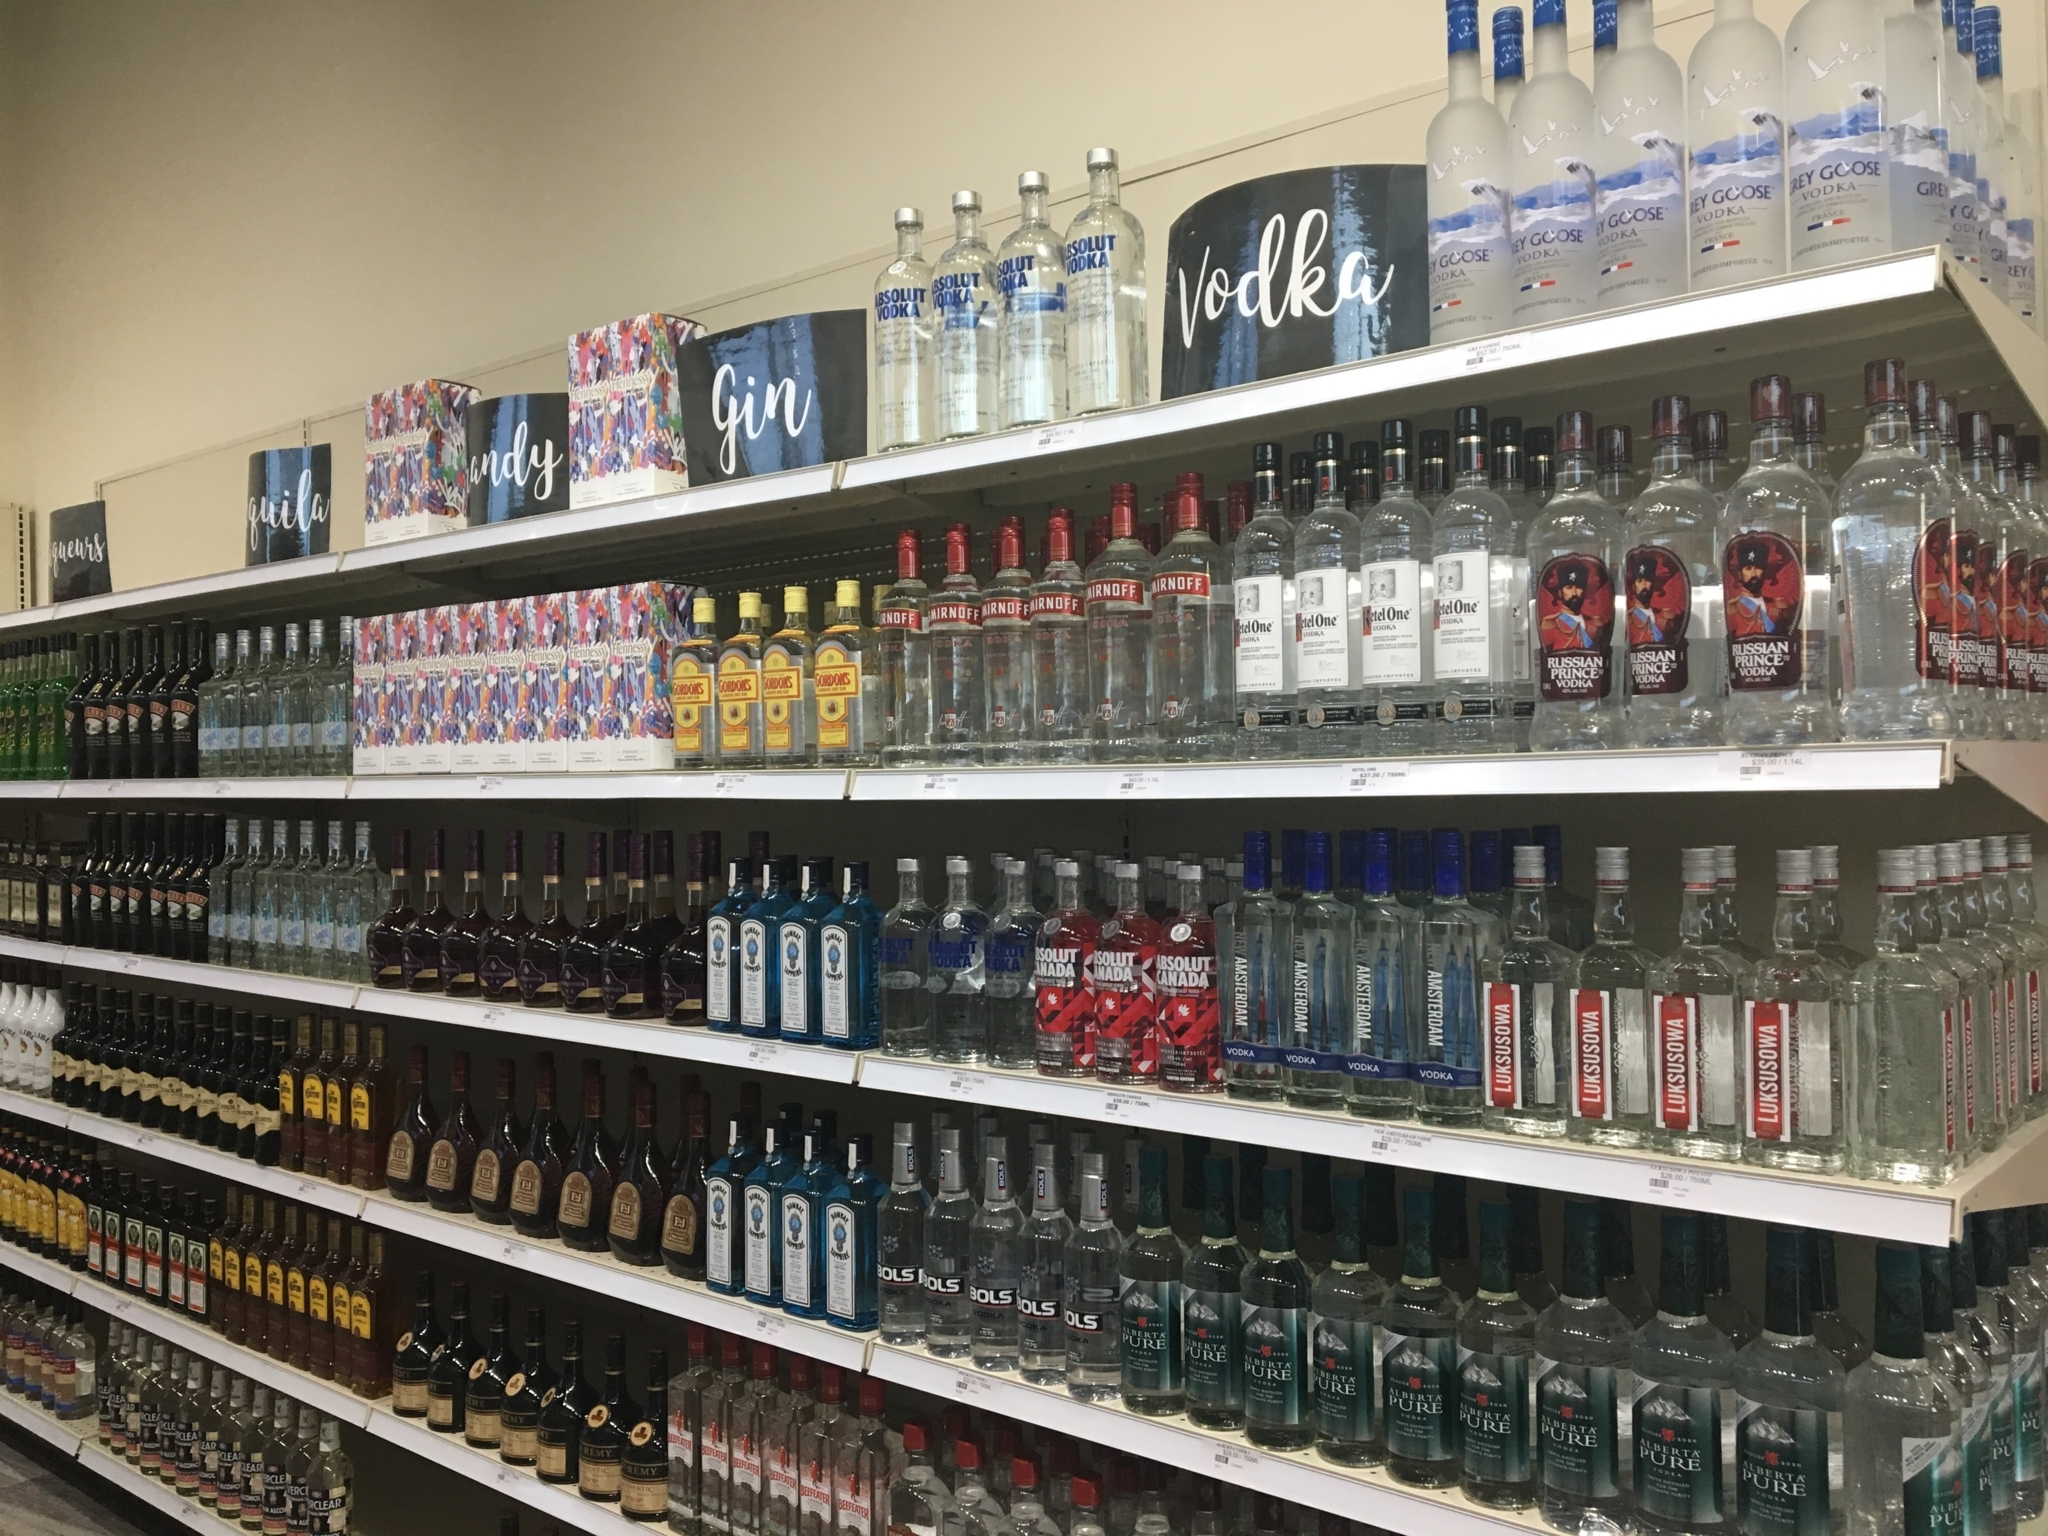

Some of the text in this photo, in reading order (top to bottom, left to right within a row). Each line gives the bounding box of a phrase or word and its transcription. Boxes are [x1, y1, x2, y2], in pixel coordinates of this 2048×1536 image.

[1789, 160, 1881, 196] REY GOOSE
[1691, 185, 1771, 214] REY GOOSE
[1802, 181, 1856, 201] VODKA
[1608, 207, 1664, 228] GOOSE
[1697, 206, 1745, 225] VODKA
[1530, 228, 1584, 247] GOOSE
[1598, 228, 1637, 247] VODKA
[1067, 251, 1110, 276] VODKA
[1439, 248, 1490, 268] GOOSE
[1517, 248, 1560, 265] VODKA
[997, 255, 1035, 277] SOLUT
[997, 272, 1028, 294] ODKA
[1178, 208, 1395, 349] Vodka
[1430, 269, 1466, 286] VODKA
[877, 303, 921, 321] VODKA
[611, 372, 652, 391] Hennessy
[712, 363, 812, 475] Gin
[466, 421, 563, 500] andy
[247, 468, 331, 551] quila
[50, 532, 105, 578] queurs
[981, 600, 1030, 617] MIRNOFF
[1387, 606, 1410, 621] One
[1454, 599, 1478, 614] One
[881, 612, 915, 625] RNOFF
[1252, 620, 1272, 633] One
[1316, 613, 1337, 627] One
[1303, 630, 1324, 638] VODKA
[1372, 624, 1397, 632] VODKA
[527, 649, 562, 663] Hennessy
[568, 646, 607, 660] Hennessy
[612, 641, 650, 656] Hennessy
[1630, 649, 1676, 663] RUSSIAN
[1732, 641, 1789, 656] RUSSIAN
[1548, 656, 1603, 669] RUSSIAN
[1632, 662, 1671, 674] PRINCE
[1735, 654, 1784, 667] PRINCE
[1551, 667, 1599, 680] PRINCE
[1635, 673, 1665, 683] VODKA
[1739, 666, 1778, 677] VODKA
[1556, 678, 1593, 688] VODKA
[710, 923, 727, 935] BOMBAY
[783, 931, 801, 942] BOMBAY
[825, 934, 843, 945] BOMBAY
[1035, 948, 1077, 963] BSOLUT
[1094, 950, 1136, 966] BSOLUT
[1156, 955, 1211, 972] ABSOLUT
[1035, 963, 1076, 978] ANADA
[1094, 966, 1133, 982] ANADA
[1157, 971, 1209, 988] CANADA
[1234, 956, 1248, 1026] AMSTERDAM
[1294, 961, 1308, 1033] AMSTERDAM
[1356, 965, 1372, 1039] AMSTERDAM
[1427, 970, 1443, 1047] AMSTERDAM
[1227, 1047, 1255, 1058] VODKA
[1495, 1003, 1512, 1093] LUKSUSOWA
[1582, 1010, 1600, 1103] LUKSUSOWA
[1286, 1054, 1316, 1065] VODKA
[1348, 1062, 1380, 1073] VODKA
[1666, 1018, 1686, 1114] LUKSUSOWA
[1419, 1070, 1454, 1081] VODKA
[1757, 1024, 1779, 1124] LUKSUSOWA
[1381, 1136, 1423, 1148] $29.00 750ML
[1660, 1172, 1712, 1186] $28.00 750ML
[711, 1186, 727, 1197] BOMBAY
[787, 1201, 805, 1214] BOMBAY
[831, 1211, 849, 1224] BOMBAY
[877, 1266, 915, 1282] BOLS
[970, 1287, 1013, 1304] BOLS
[1018, 1298, 1056, 1316] BOLS
[1122, 1333, 1166, 1349] PURE
[1123, 1327, 1165, 1339] ALBERTA
[1185, 1343, 1227, 1362] PURE
[1245, 1354, 1291, 1369] ALBERTA
[1245, 1364, 1292, 1381] PURE
[1314, 1375, 1356, 1395] PURE
[1389, 1387, 1442, 1400] ALBERTA
[1389, 1395, 1443, 1414] PURE
[1460, 1403, 1510, 1421] ALBERTA
[1460, 1410, 1511, 1434] PURE
[1541, 1415, 1596, 1434] ALBERTA
[668, 1433, 692, 1451] BEEFEATER
[1542, 1424, 1597, 1447] PURE
[701, 1445, 728, 1463] BEEFEATER
[1640, 1437, 1700, 1457] ALBERTA
[1243, 1455, 1259, 1465] 750ML
[1640, 1446, 1701, 1471] PURE
[733, 1458, 760, 1477] BEEFEATER
[1742, 1460, 1805, 1482] ALBERTA
[770, 1471, 797, 1490] BEEFEATER
[1743, 1468, 1806, 1496] PURE
[800, 1485, 830, 1505] BEEFEATER
[838, 1500, 869, 1521] BEEFEATER
